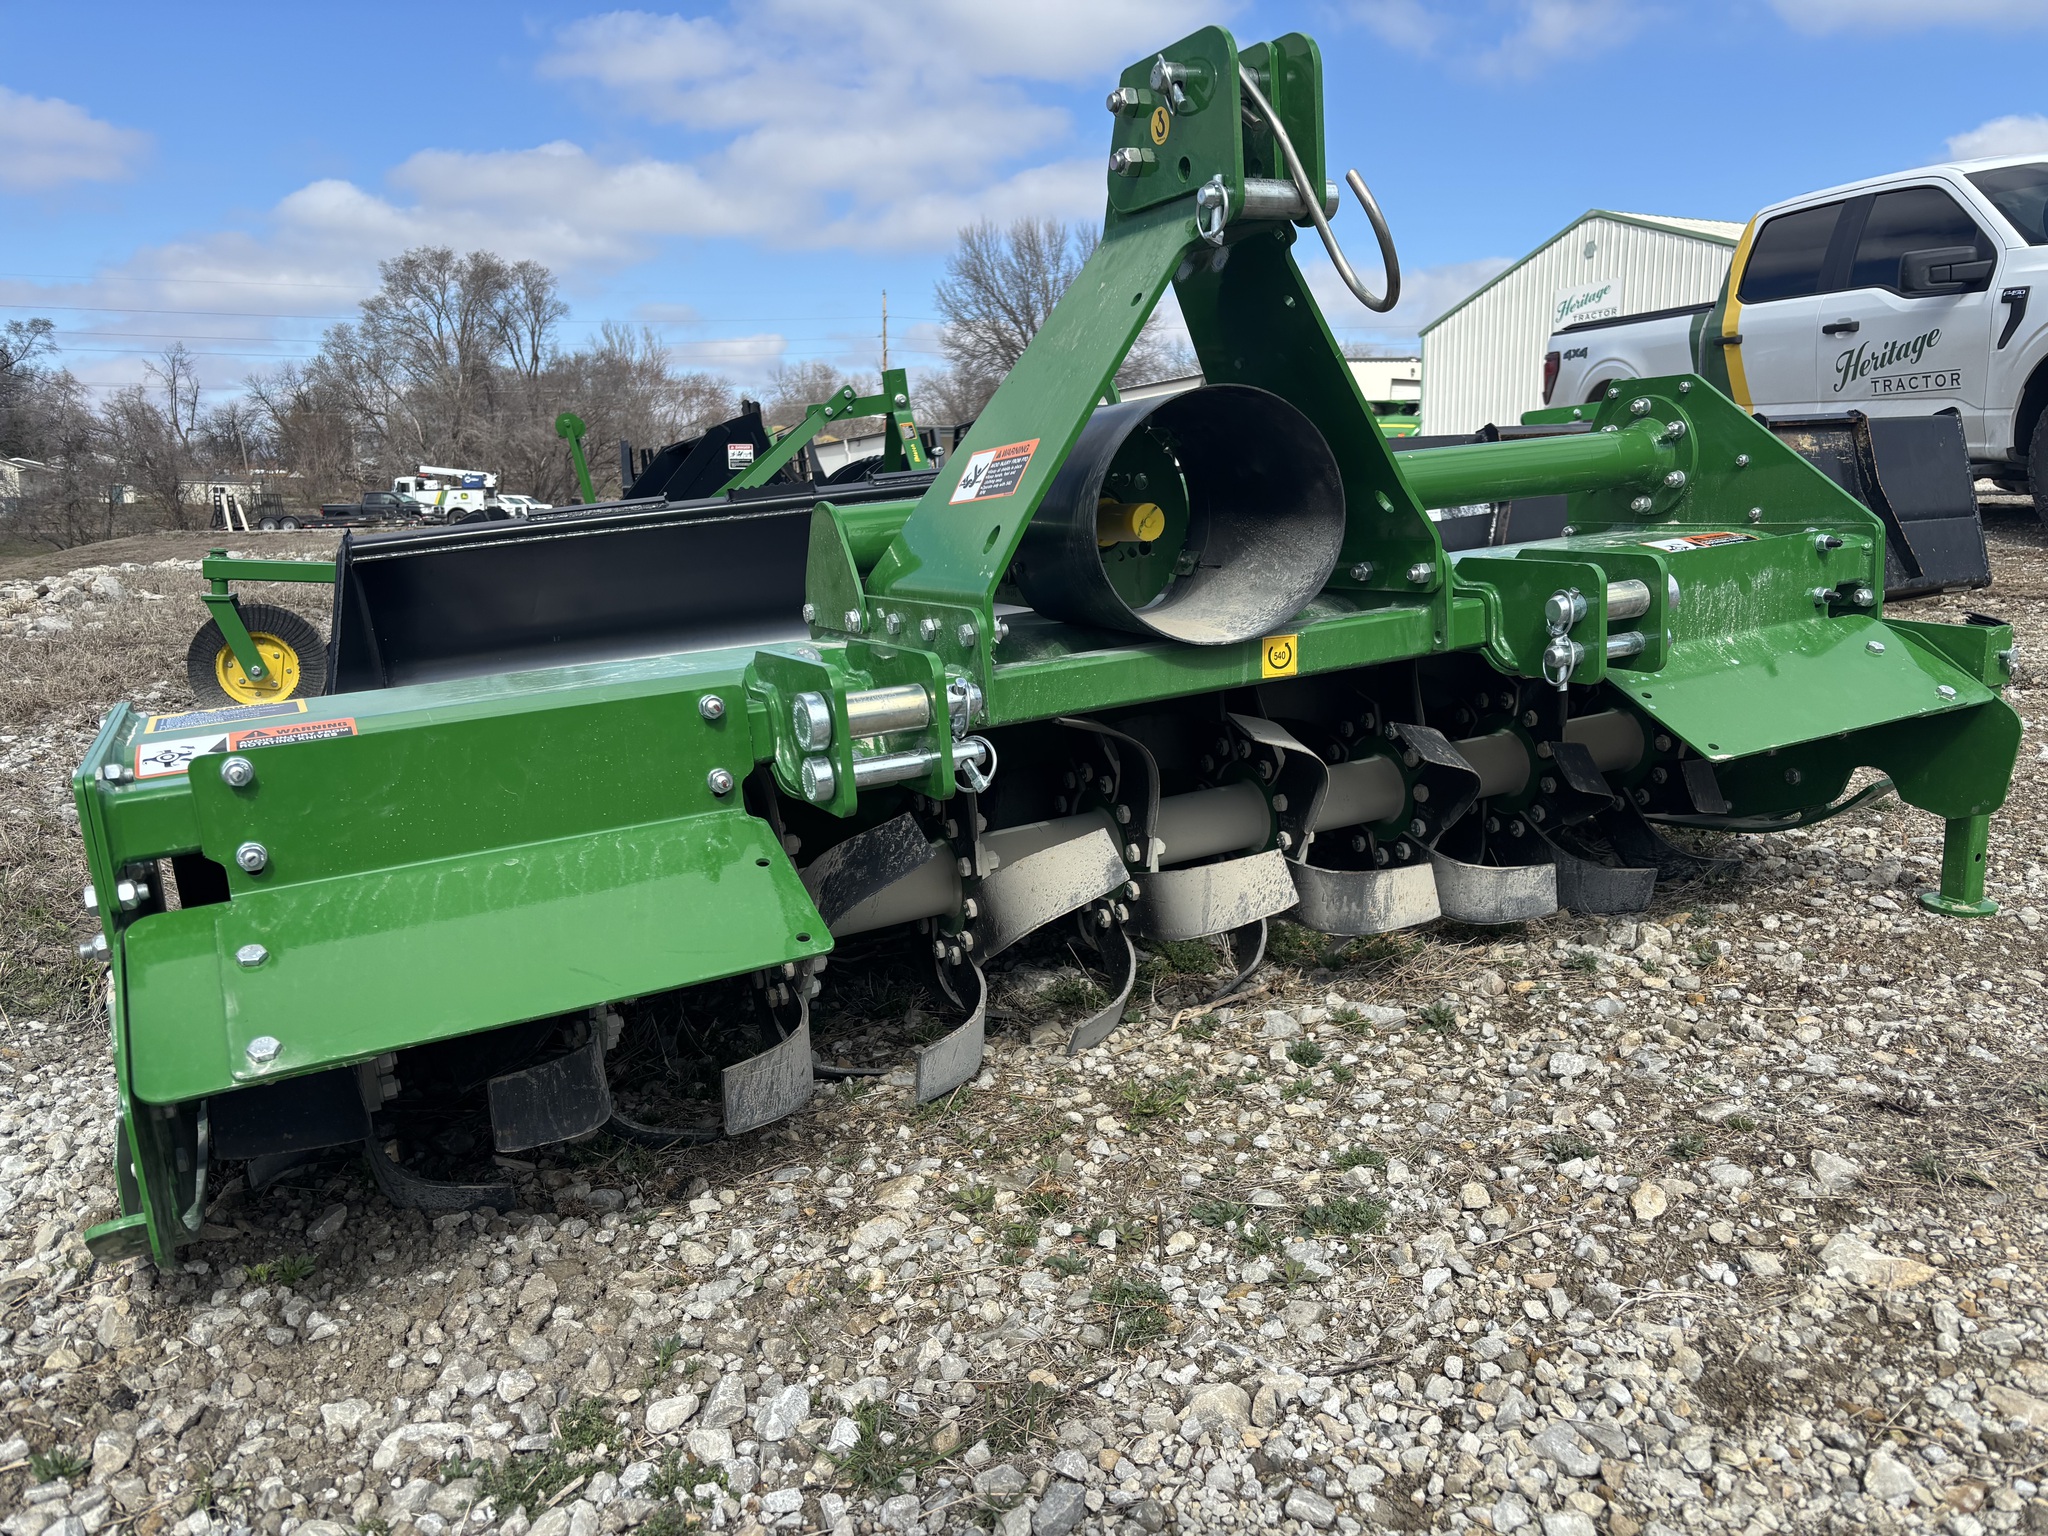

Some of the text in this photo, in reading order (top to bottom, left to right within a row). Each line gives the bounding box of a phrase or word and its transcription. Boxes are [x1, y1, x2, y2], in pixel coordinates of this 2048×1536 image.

[1555, 285, 1611, 323] Heritage
[1573, 308, 1618, 322] TRACTOR
[1833, 328, 1942, 393] Heritage
[1871, 372, 1961, 393] TRACTOR
[1002, 443, 1031, 458] WARNING
[1273, 651, 1286, 660] 540
[276, 721, 348, 735] WARNING
[239, 732, 338, 748] ROTATING KNIVES
[274, 731, 314, 741] INJURY
